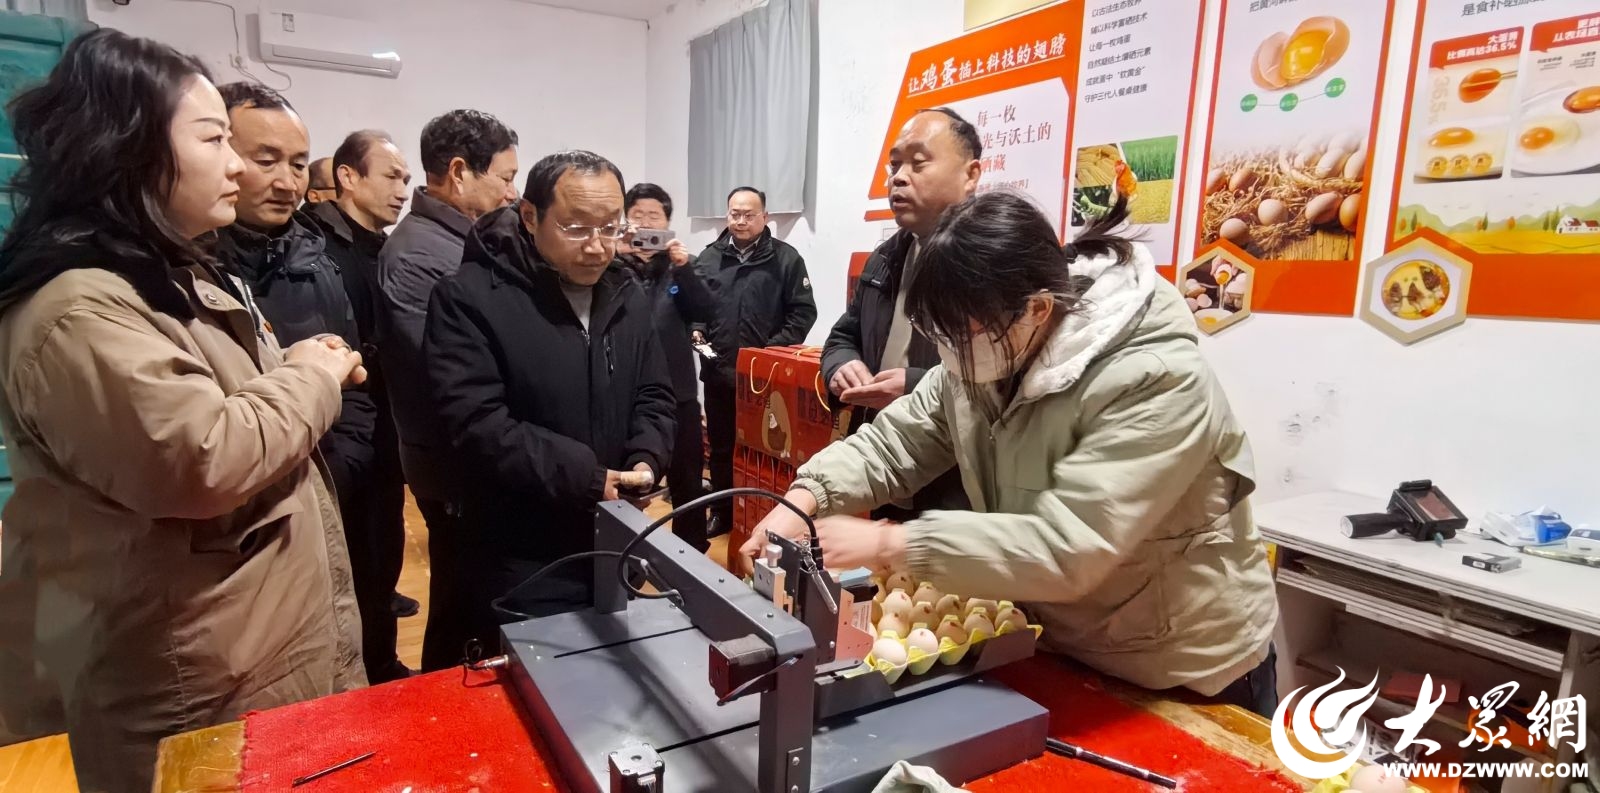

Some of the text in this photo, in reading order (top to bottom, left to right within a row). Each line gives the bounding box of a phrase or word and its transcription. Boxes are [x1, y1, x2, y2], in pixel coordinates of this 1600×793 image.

[908, 33, 1067, 93] 让鸡蛋插上科技的翅膀
